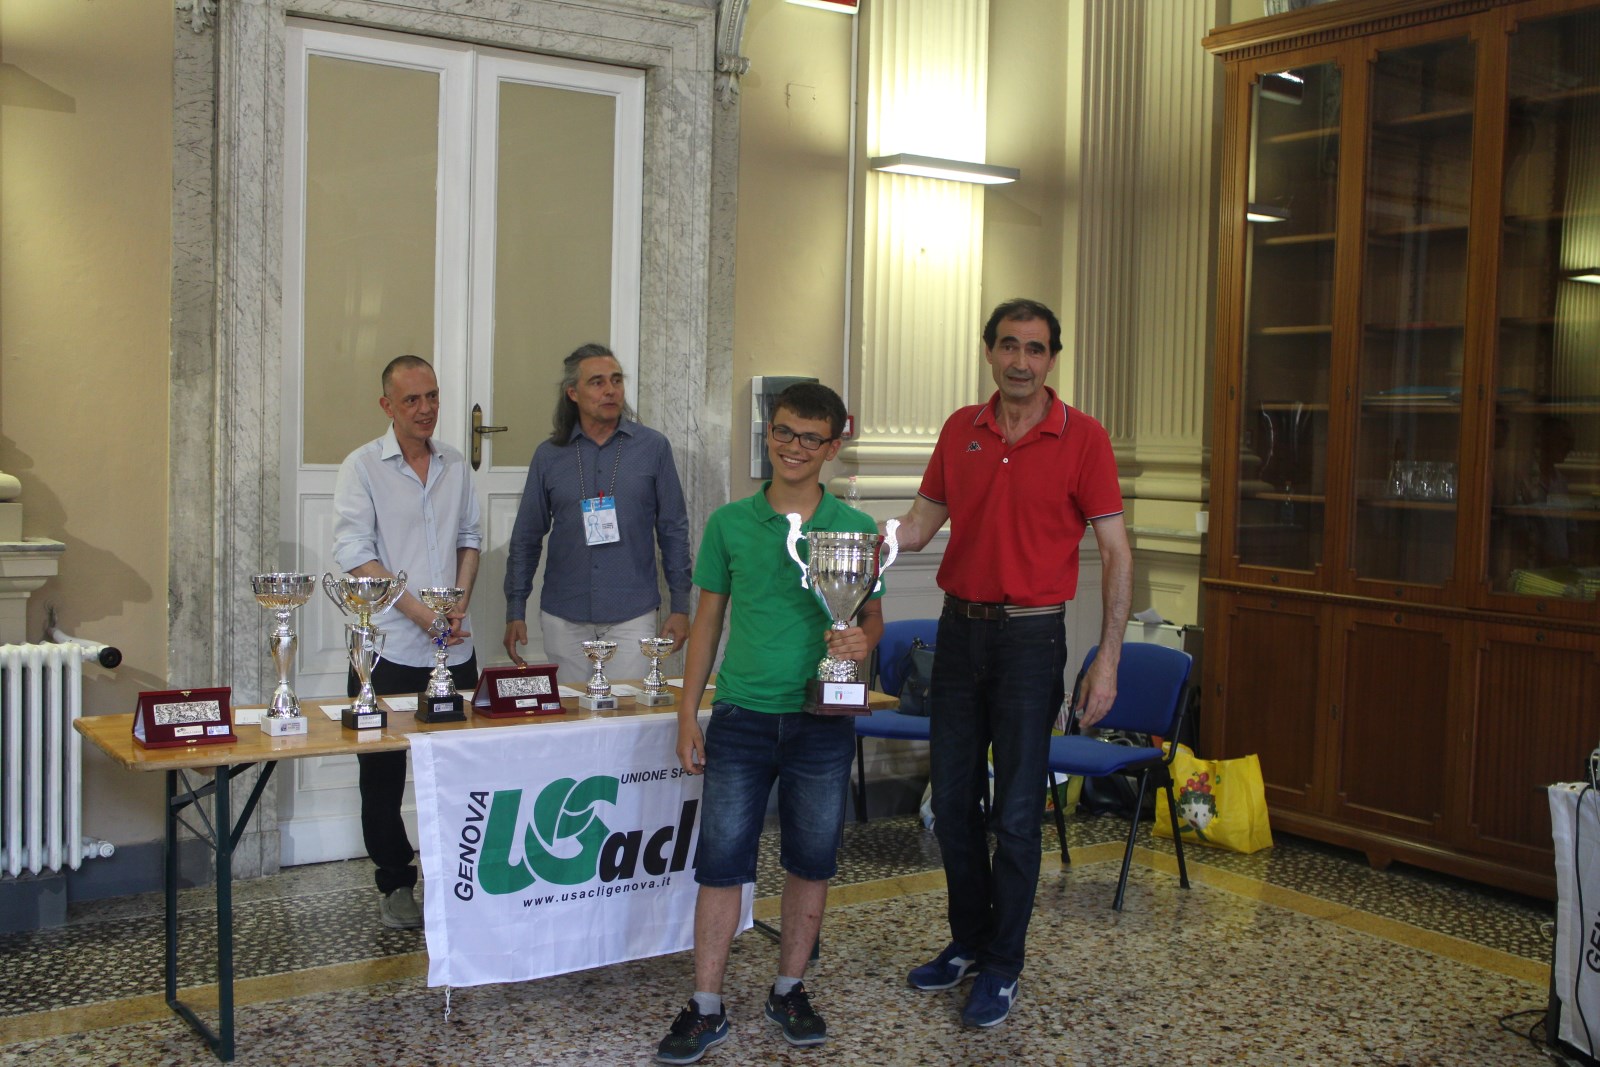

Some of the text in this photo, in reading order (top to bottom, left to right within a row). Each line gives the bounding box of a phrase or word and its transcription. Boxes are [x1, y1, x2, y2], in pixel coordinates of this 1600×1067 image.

[620, 769, 667, 784] UNIONE
[454, 791, 489, 901] GENOVA
[523, 876, 671, 907] www.usacligenova.it
